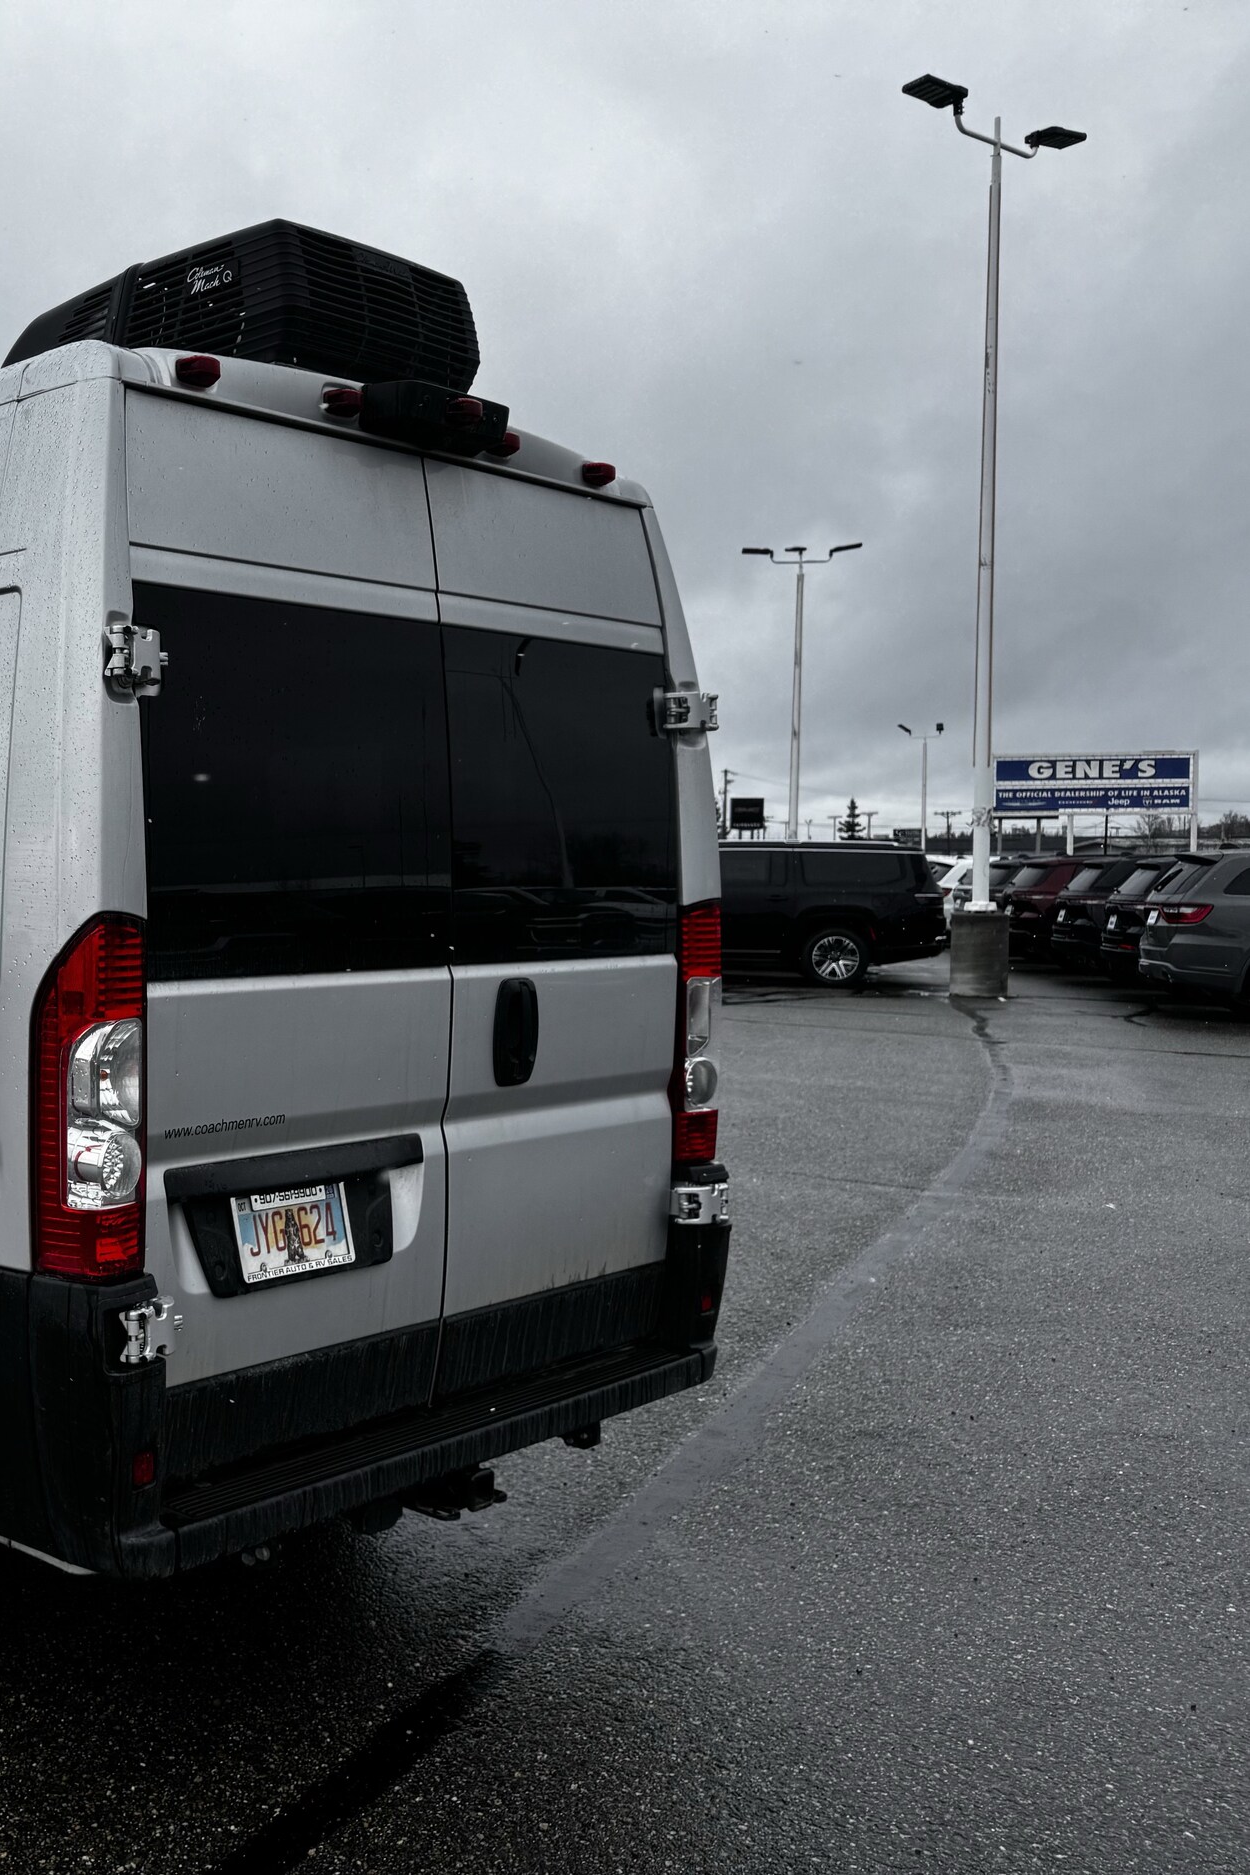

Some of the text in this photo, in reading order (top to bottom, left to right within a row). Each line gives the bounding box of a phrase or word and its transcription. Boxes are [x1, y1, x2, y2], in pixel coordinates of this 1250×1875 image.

[191, 270, 233, 295] Mach Q
[1028, 759, 1156, 779] GENE'S
[998, 791, 1013, 799] THE
[1054, 790, 1105, 798] DEALERSHIP
[1121, 789, 1138, 797] LIFE
[1140, 789, 1150, 797] IN
[1108, 797, 1130, 806] Jeep
[164, 1113, 286, 1140] www.coachmenrv.com
[237, 1201, 247, 1212] OCT
[250, 1201, 338, 1257] JYG 624
[247, 1268, 285, 1282] FRONTIER
[285, 1263, 307, 1274] AUTO
[315, 1260, 326, 1268] RV
[327, 1255, 353, 1266] SALES
